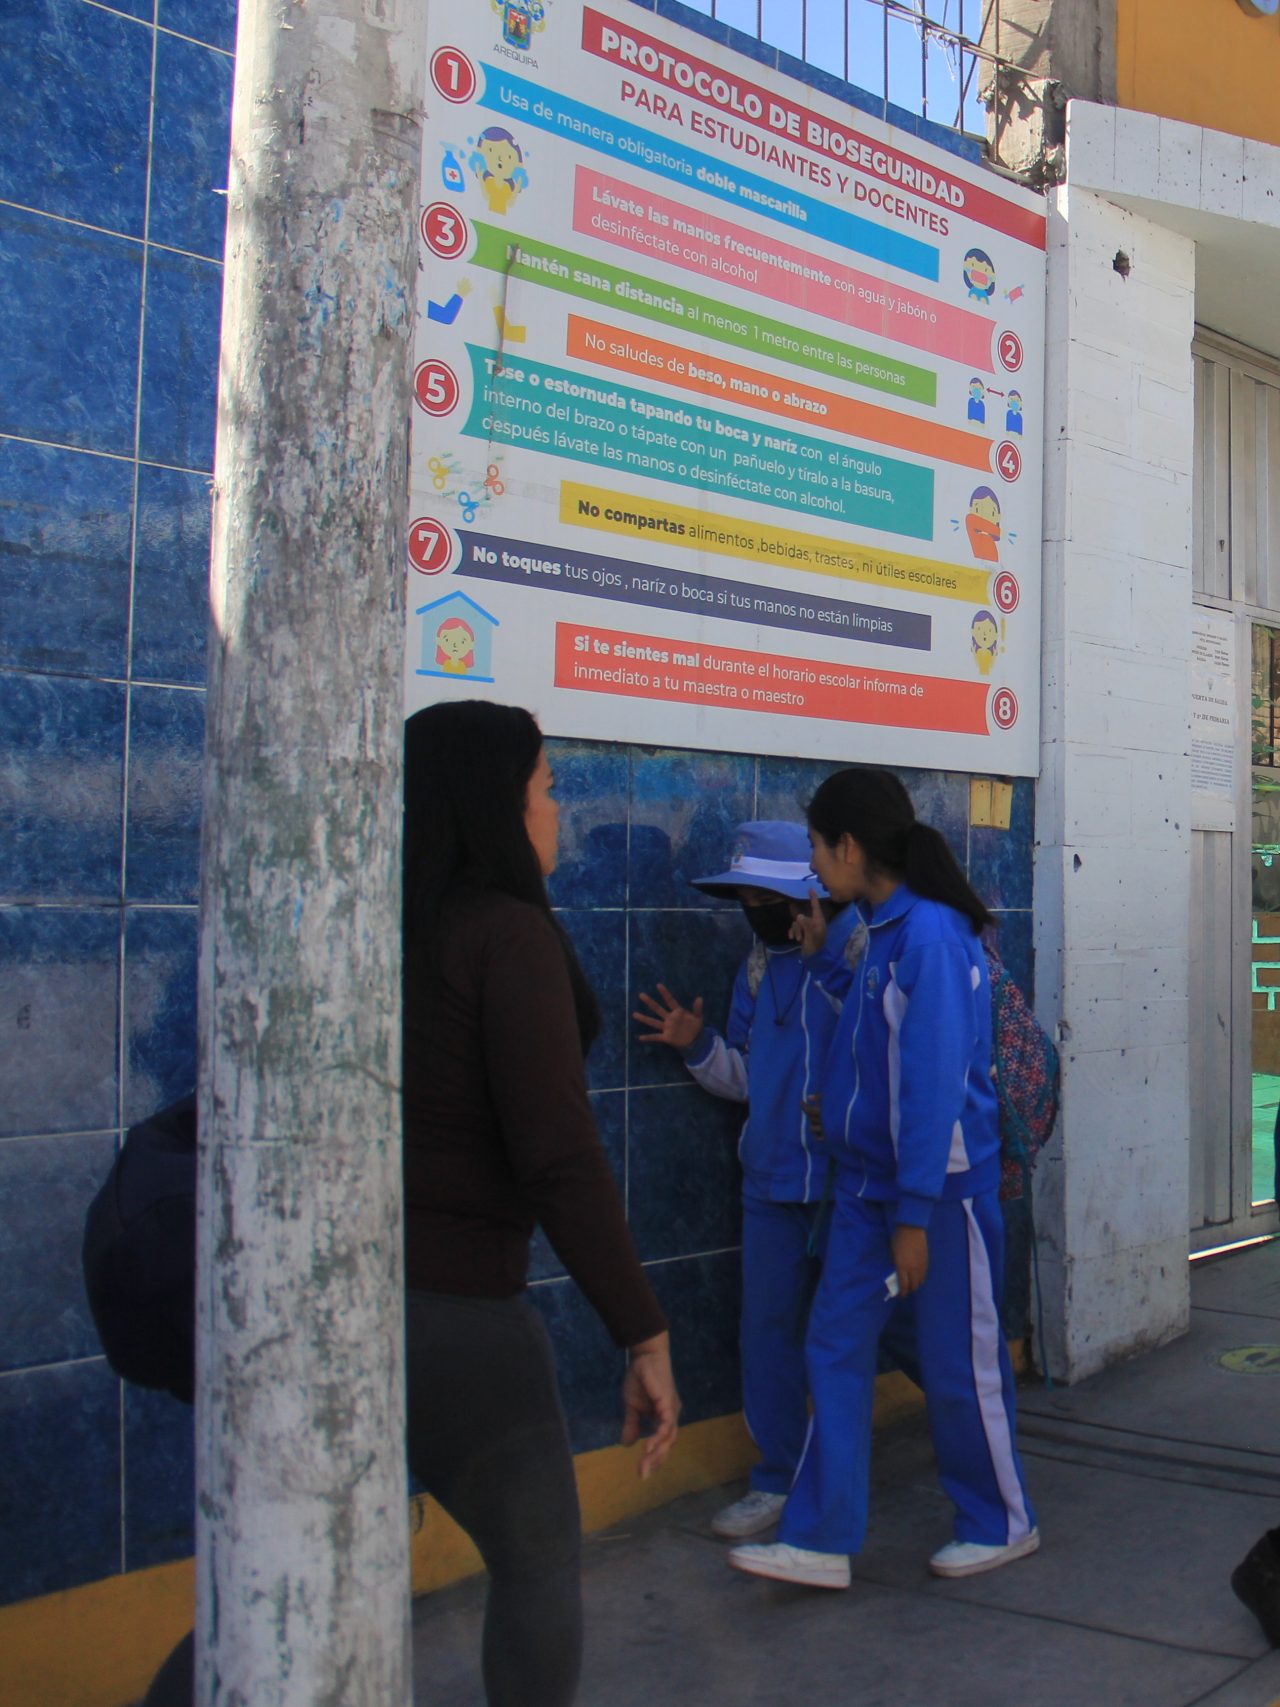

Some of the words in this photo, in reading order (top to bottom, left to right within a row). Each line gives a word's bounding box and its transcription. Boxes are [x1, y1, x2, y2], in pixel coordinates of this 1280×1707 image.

[446, 58, 459, 91] 1
[493, 44, 539, 69] AREQUIPA
[602, 27, 762, 119] PROTOCOLO
[769, 103, 801, 136] DE
[807, 121, 965, 208] BIOSEGURIDAD
[500, 86, 529, 112] Usa
[533, 101, 553, 121] de
[557, 112, 614, 145] manera
[618, 136, 693, 176] obligatoria
[696, 165, 736, 194] doble
[739, 184, 808, 222] mascarilla
[621, 80, 685, 126] PARA
[690, 110, 832, 188] ESTUDIANTES
[836, 172, 850, 193] Y
[854, 181, 950, 237] DOCENTES
[435, 214, 456, 247] 3
[591, 214, 680, 256] desinféctate
[683, 249, 708, 266] con
[711, 257, 758, 283] alcohol
[592, 187, 644, 217] Lávate
[647, 204, 669, 227] las
[673, 219, 721, 246] manos
[724, 236, 832, 286] frecuentemente
[834, 279, 855, 295] con
[858, 287, 886, 306] agua
[887, 297, 895, 311] y
[896, 297, 928, 321] jabón
[929, 311, 937, 324] o
[506, 245, 569, 279] Mantén
[574, 268, 611, 292] sana
[615, 282, 684, 316] distancia
[687, 302, 700, 320] al
[703, 313, 747, 336] menos
[753, 327, 759, 340] 1
[762, 330, 799, 352] metro
[802, 343, 833, 363] entre
[837, 352, 853, 369] las
[855, 358, 906, 386] personas
[585, 333, 606, 351] No
[609, 340, 664, 369] saludes
[667, 357, 685, 374] de
[688, 363, 726, 388] beso,
[730, 380, 768, 398] mano
[772, 390, 781, 402] o
[784, 394, 828, 415] abrazo
[1005, 340, 1017, 364] 2
[426, 372, 445, 404] 5
[482, 385, 542, 415] interno
[546, 402, 570, 421] del
[574, 408, 615, 432] brazo
[618, 424, 628, 436] o
[631, 425, 677, 448] tápate
[680, 439, 706, 455] con
[709, 446, 727, 461] un
[733, 454, 785, 475] pañuelo
[788, 465, 796, 480] y
[798, 464, 829, 486] tíralo
[831, 477, 840, 489] a
[841, 476, 852, 492] la
[854, 481, 895, 504] basura,
[529, 373, 540, 386] o
[544, 378, 626, 409] estornuda
[629, 398, 692, 426] tapando
[695, 414, 712, 431] tu
[715, 419, 749, 442] boca
[752, 432, 762, 447] y
[764, 435, 798, 455] naríz
[800, 447, 823, 461] con
[828, 450, 839, 465] el
[842, 453, 882, 476] ángulo
[481, 415, 550, 444] después
[554, 431, 599, 455] lávate
[603, 443, 623, 461] las
[626, 451, 675, 474] manos
[678, 465, 687, 477] o
[690, 465, 772, 496] desinféctate
[774, 486, 797, 502] con
[800, 490, 846, 514] alcohol.
[1002, 451, 1015, 472] 4
[417, 530, 439, 562] 7
[577, 500, 600, 517] No
[604, 507, 686, 535] compartas
[688, 525, 754, 550] alimentos
[814, 550, 854, 570] trastes
[862, 559, 873, 573] ni
[876, 561, 906, 580] útiles
[908, 569, 957, 590] escolares
[472, 546, 498, 565] No
[501, 553, 562, 576] toques
[564, 564, 589, 581] tus
[632, 577, 666, 594] naríz
[669, 584, 678, 596] o
[681, 583, 714, 602] boca
[717, 589, 728, 603] si
[730, 593, 751, 609] tus
[754, 600, 796, 617] manos
[799, 606, 815, 620] no
[817, 609, 850, 625] están
[852, 612, 893, 632] limpias
[1001, 580, 1013, 604] 6
[573, 662, 649, 687] inmediato
[652, 675, 661, 688] a
[664, 674, 679, 690] tu
[683, 679, 737, 699] maestra
[740, 687, 749, 699] o
[752, 688, 804, 706] maestro
[574, 635, 590, 653] Si
[593, 640, 610, 655] te
[613, 641, 669, 664] sientes
[672, 651, 700, 668] mal
[703, 656, 755, 675] durante
[758, 662, 769, 677] el
[773, 665, 816, 683] horario
[819, 670, 860, 689] escolar
[863, 676, 907, 695] informa
[909, 683, 924, 697] de
[998, 697, 1011, 720] 8
